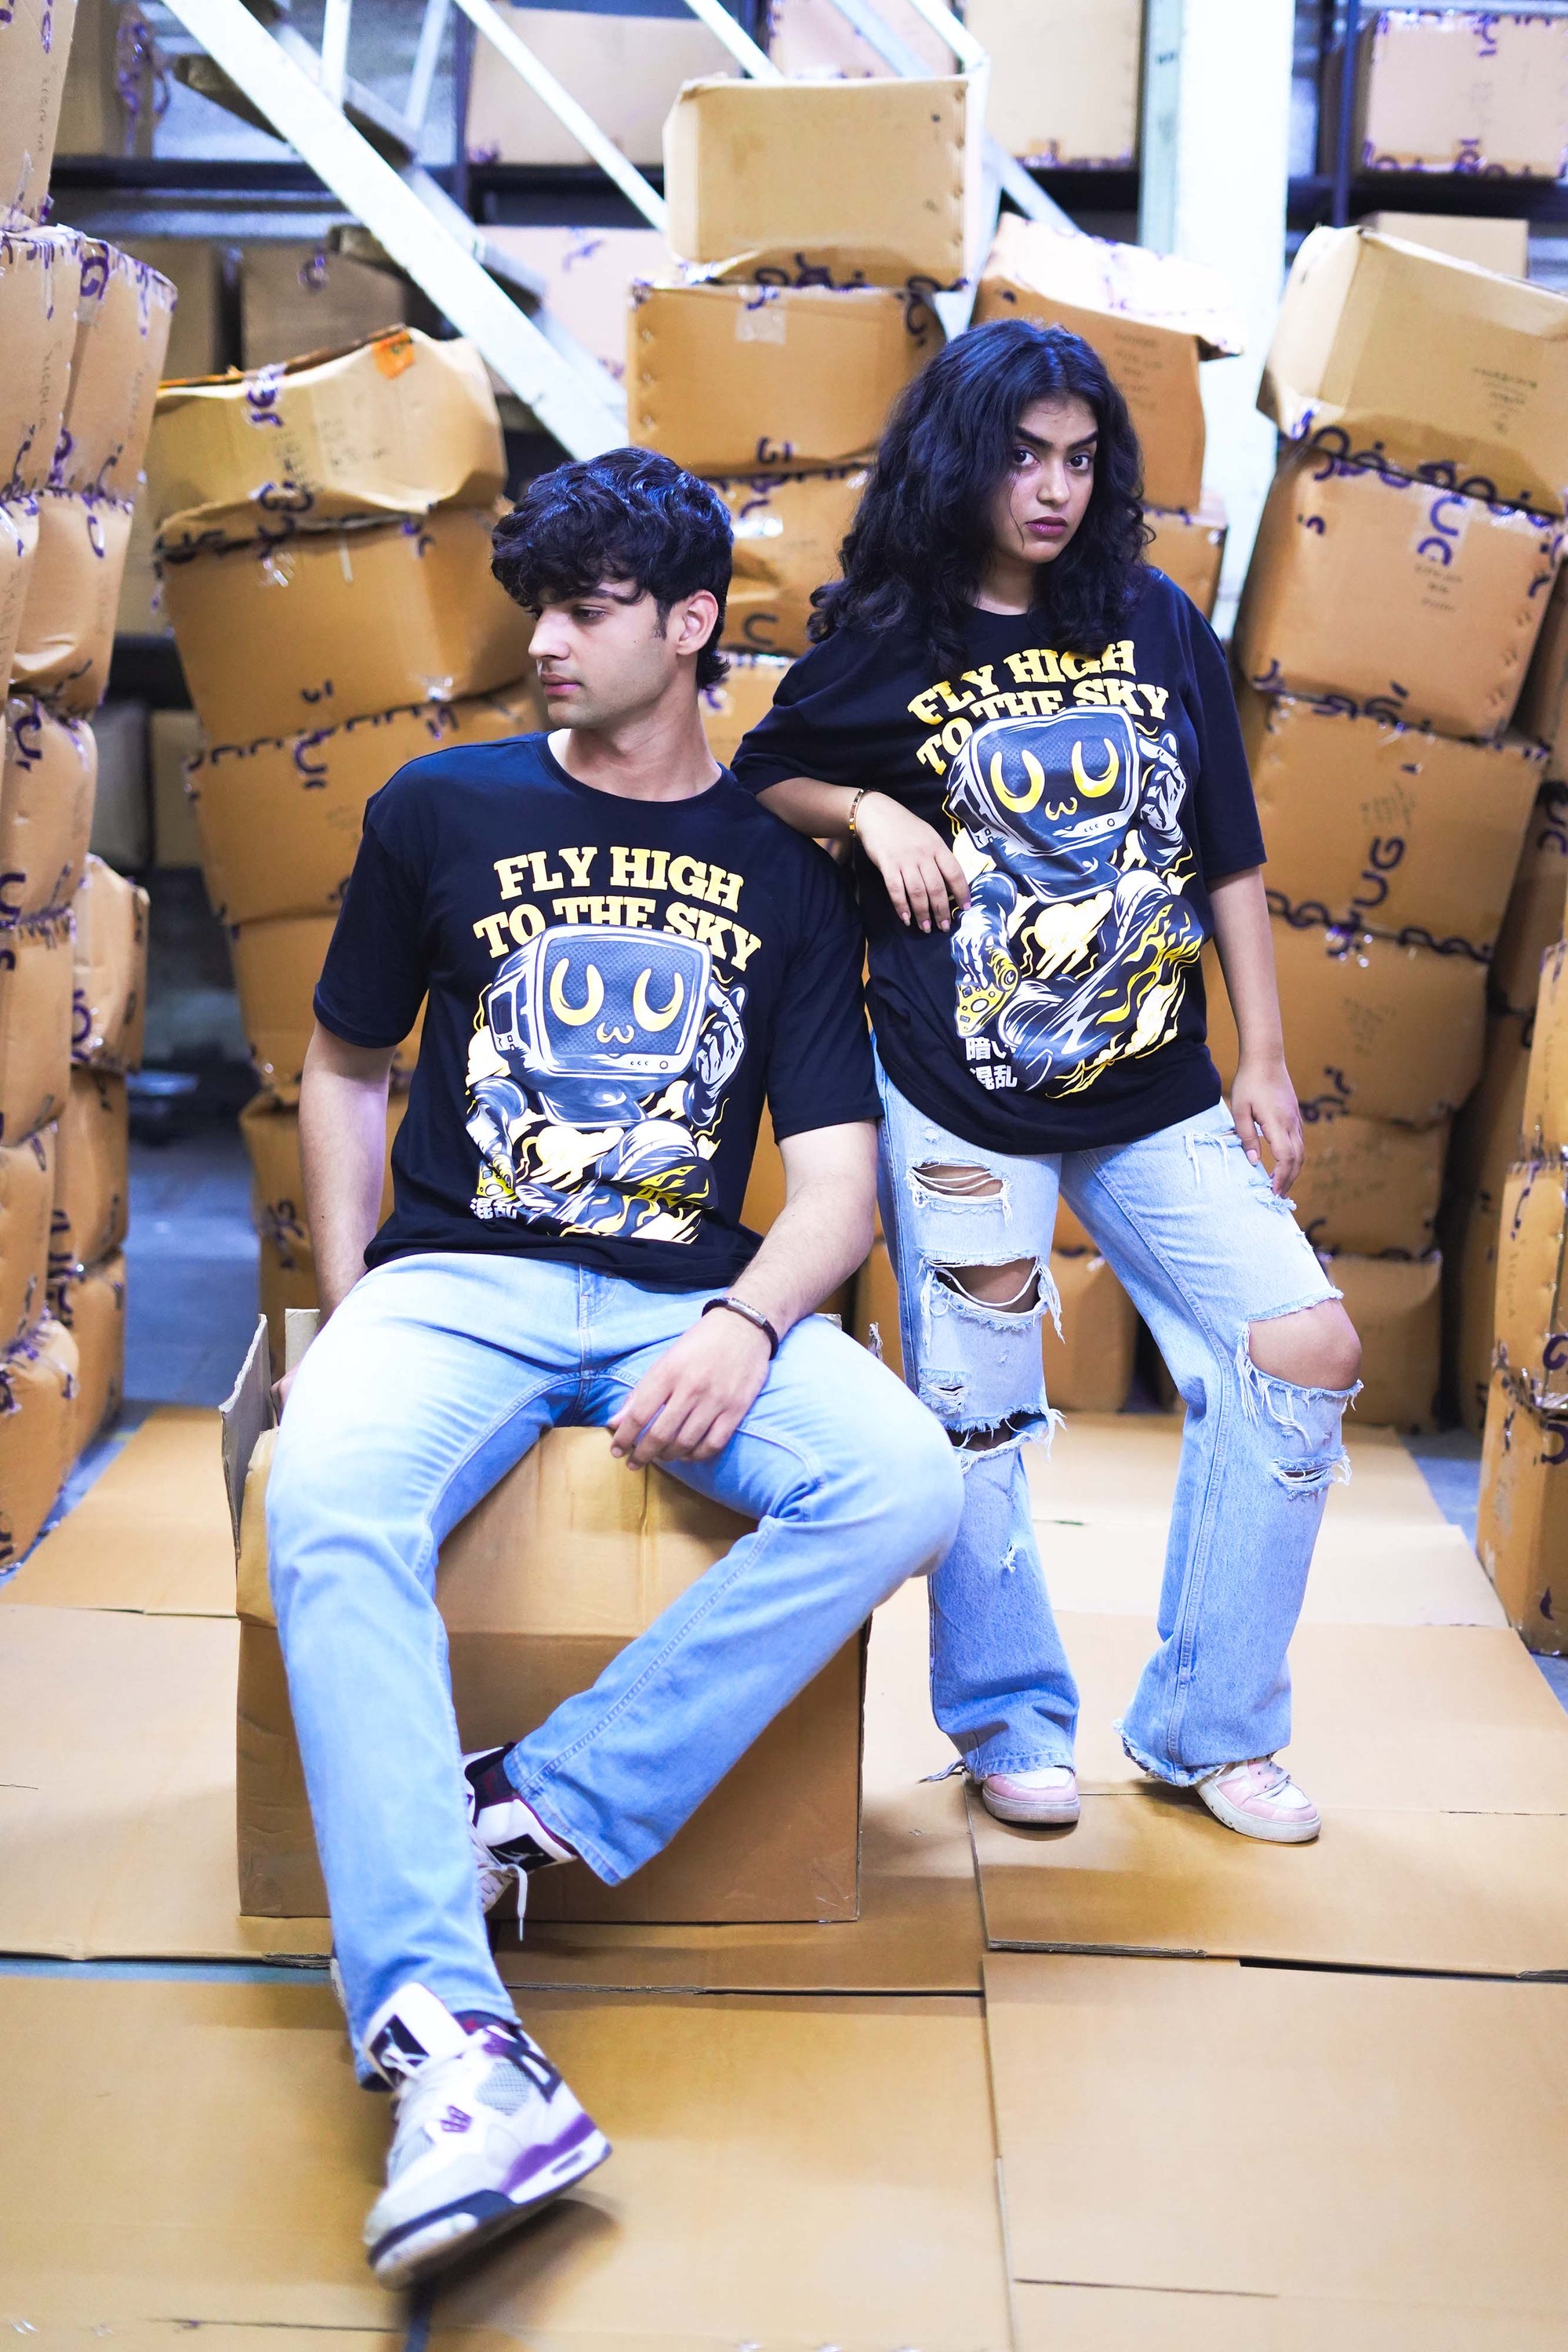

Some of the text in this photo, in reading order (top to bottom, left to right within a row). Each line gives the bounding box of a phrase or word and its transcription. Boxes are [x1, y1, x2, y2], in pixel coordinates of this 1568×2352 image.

[907, 640, 1136, 725] FLY HIGH
[916, 678, 1169, 775] TO THE SKY
[493, 846, 744, 913] FLY HIGH
[472, 895, 761, 972] TO THE SKY
[965, 1036, 1018, 1061] 暗い
